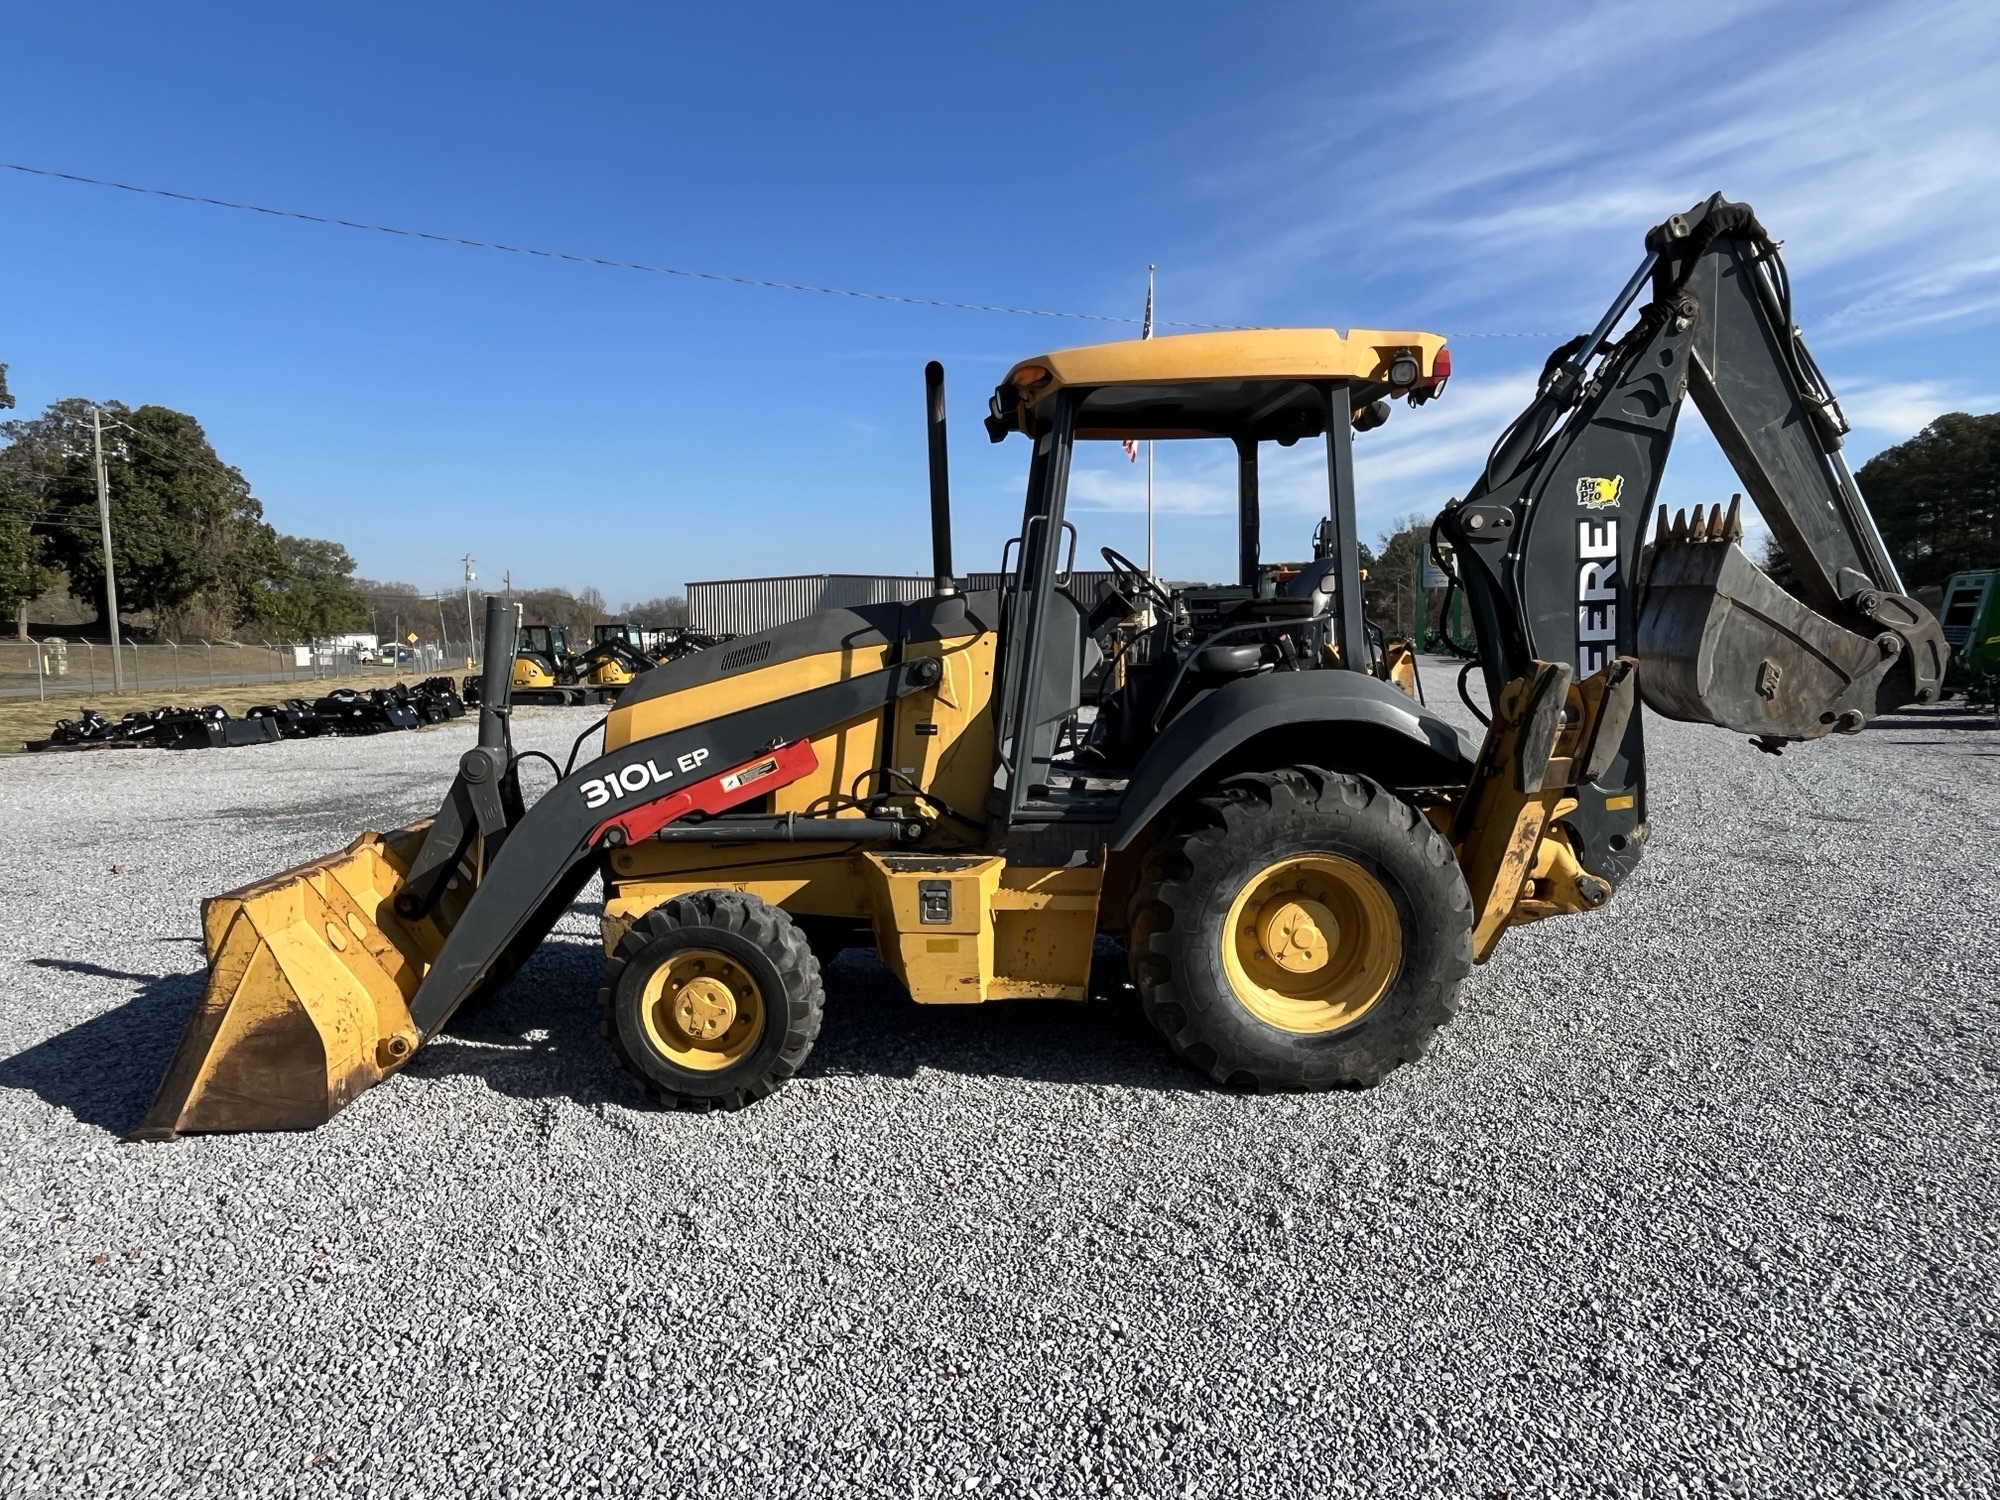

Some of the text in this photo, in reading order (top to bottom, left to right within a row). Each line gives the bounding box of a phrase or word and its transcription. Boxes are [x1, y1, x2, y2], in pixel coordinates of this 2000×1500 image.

[1580, 491, 1602, 502] Pro
[579, 760, 674, 809] 310L
[676, 748, 710, 773] EP
